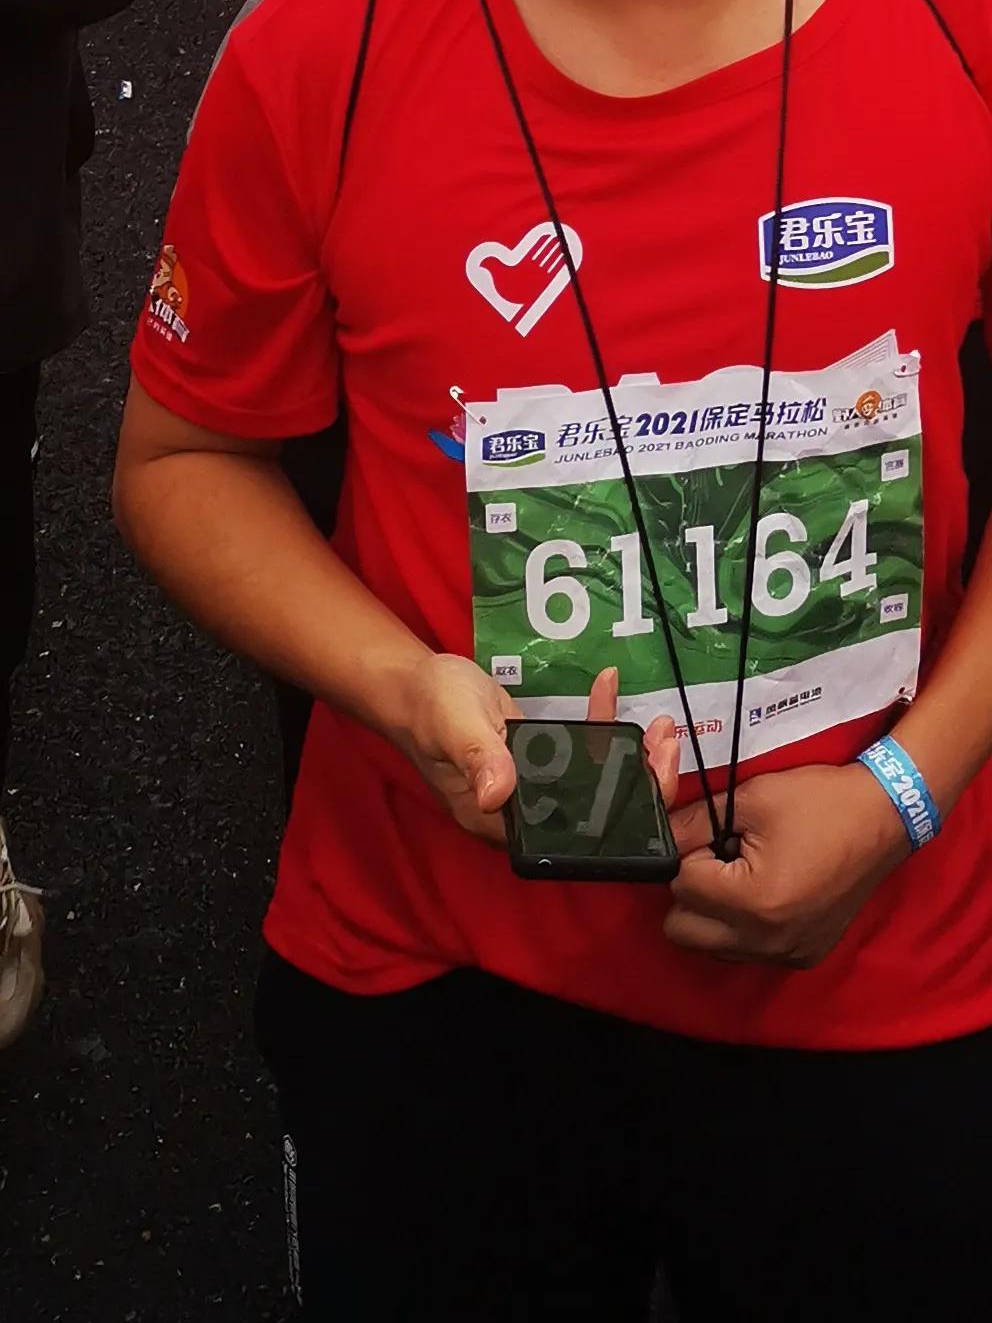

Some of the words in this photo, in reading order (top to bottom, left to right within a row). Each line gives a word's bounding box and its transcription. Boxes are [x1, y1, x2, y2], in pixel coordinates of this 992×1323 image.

[778, 210, 877, 251] 君乐宝
[778, 251, 834, 265] JUNLEBAO
[487, 432, 541, 455] 君乐宝
[554, 444, 635, 464] JUNLEBAO
[637, 441, 672, 453] 2021
[674, 433, 740, 452] BAODING
[743, 425, 829, 442] MARATHON
[525, 498, 878, 641] 61164
[674, 718, 723, 739] 东运动
